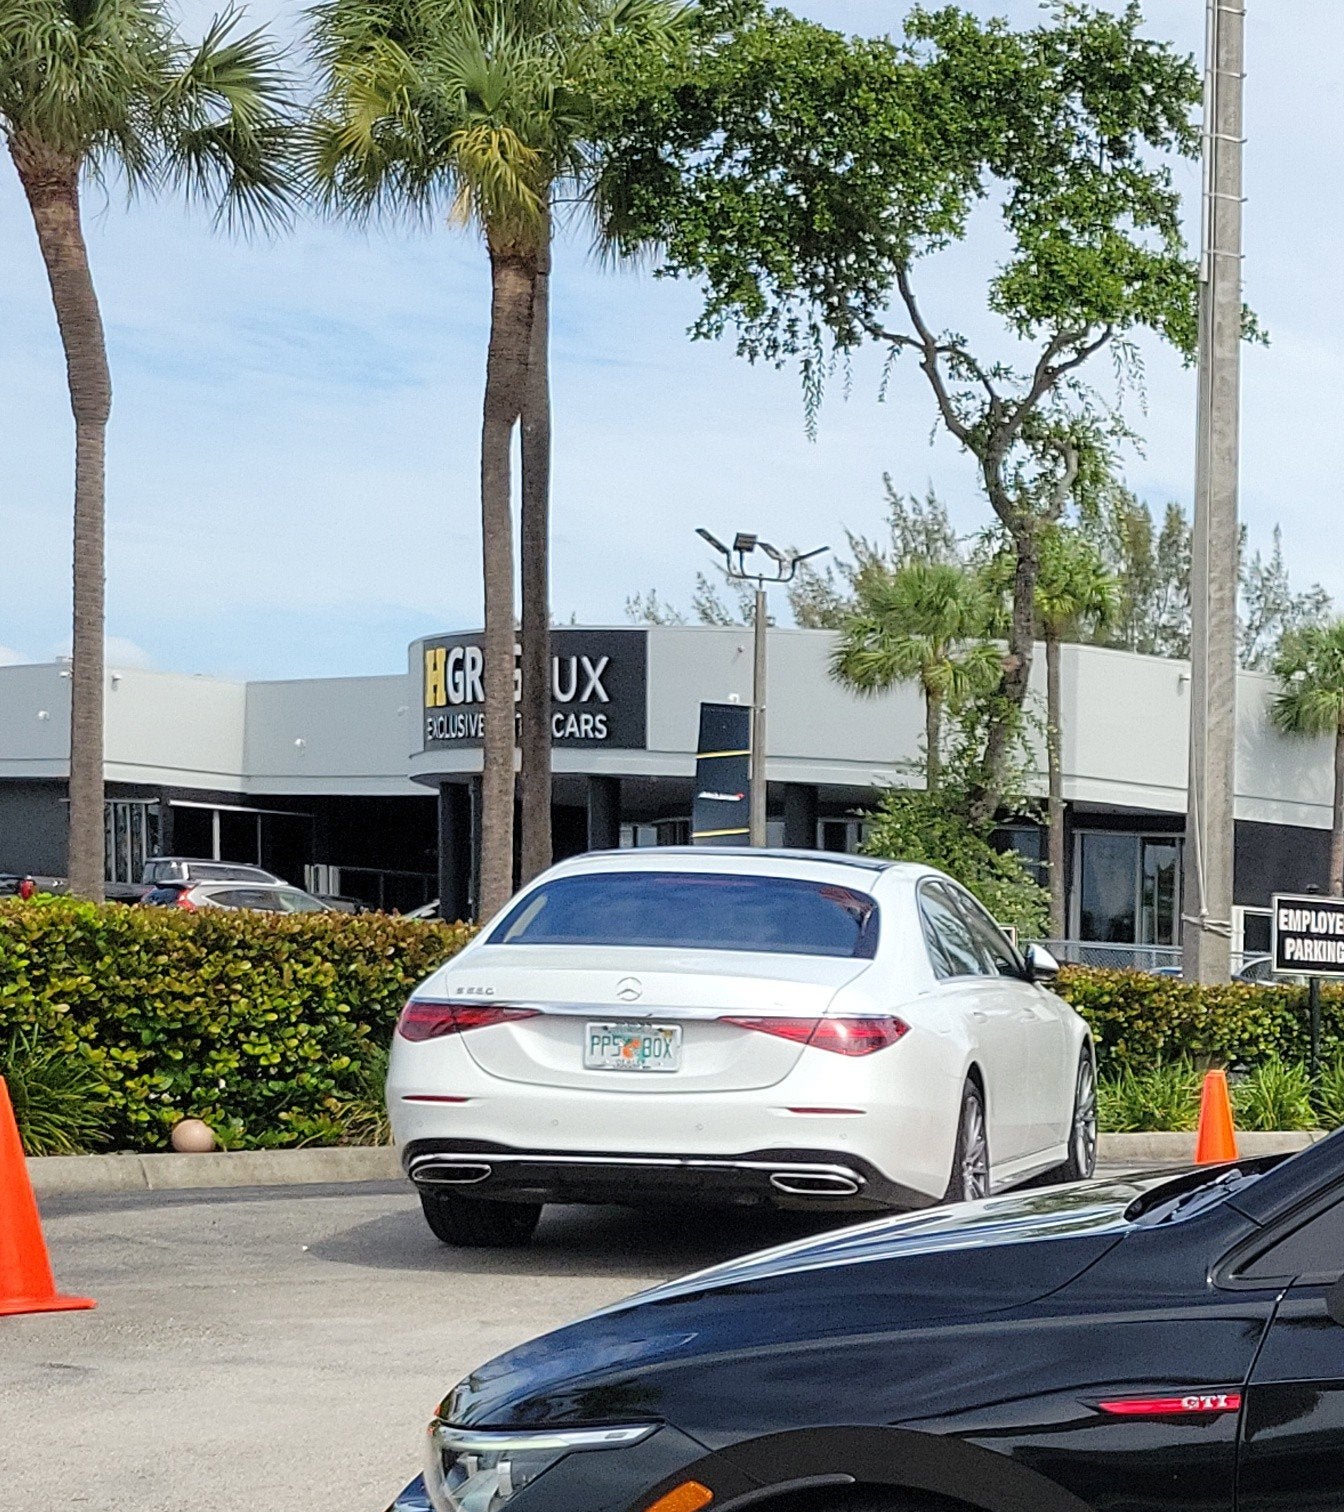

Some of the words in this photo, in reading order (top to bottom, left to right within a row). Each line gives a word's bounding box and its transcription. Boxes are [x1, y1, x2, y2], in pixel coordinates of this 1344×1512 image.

[551, 655, 610, 703] UX
[426, 712, 485, 740] EXCLUSIVE
[551, 712, 608, 739] CARS
[1181, 1395, 1228, 1410] GTI
